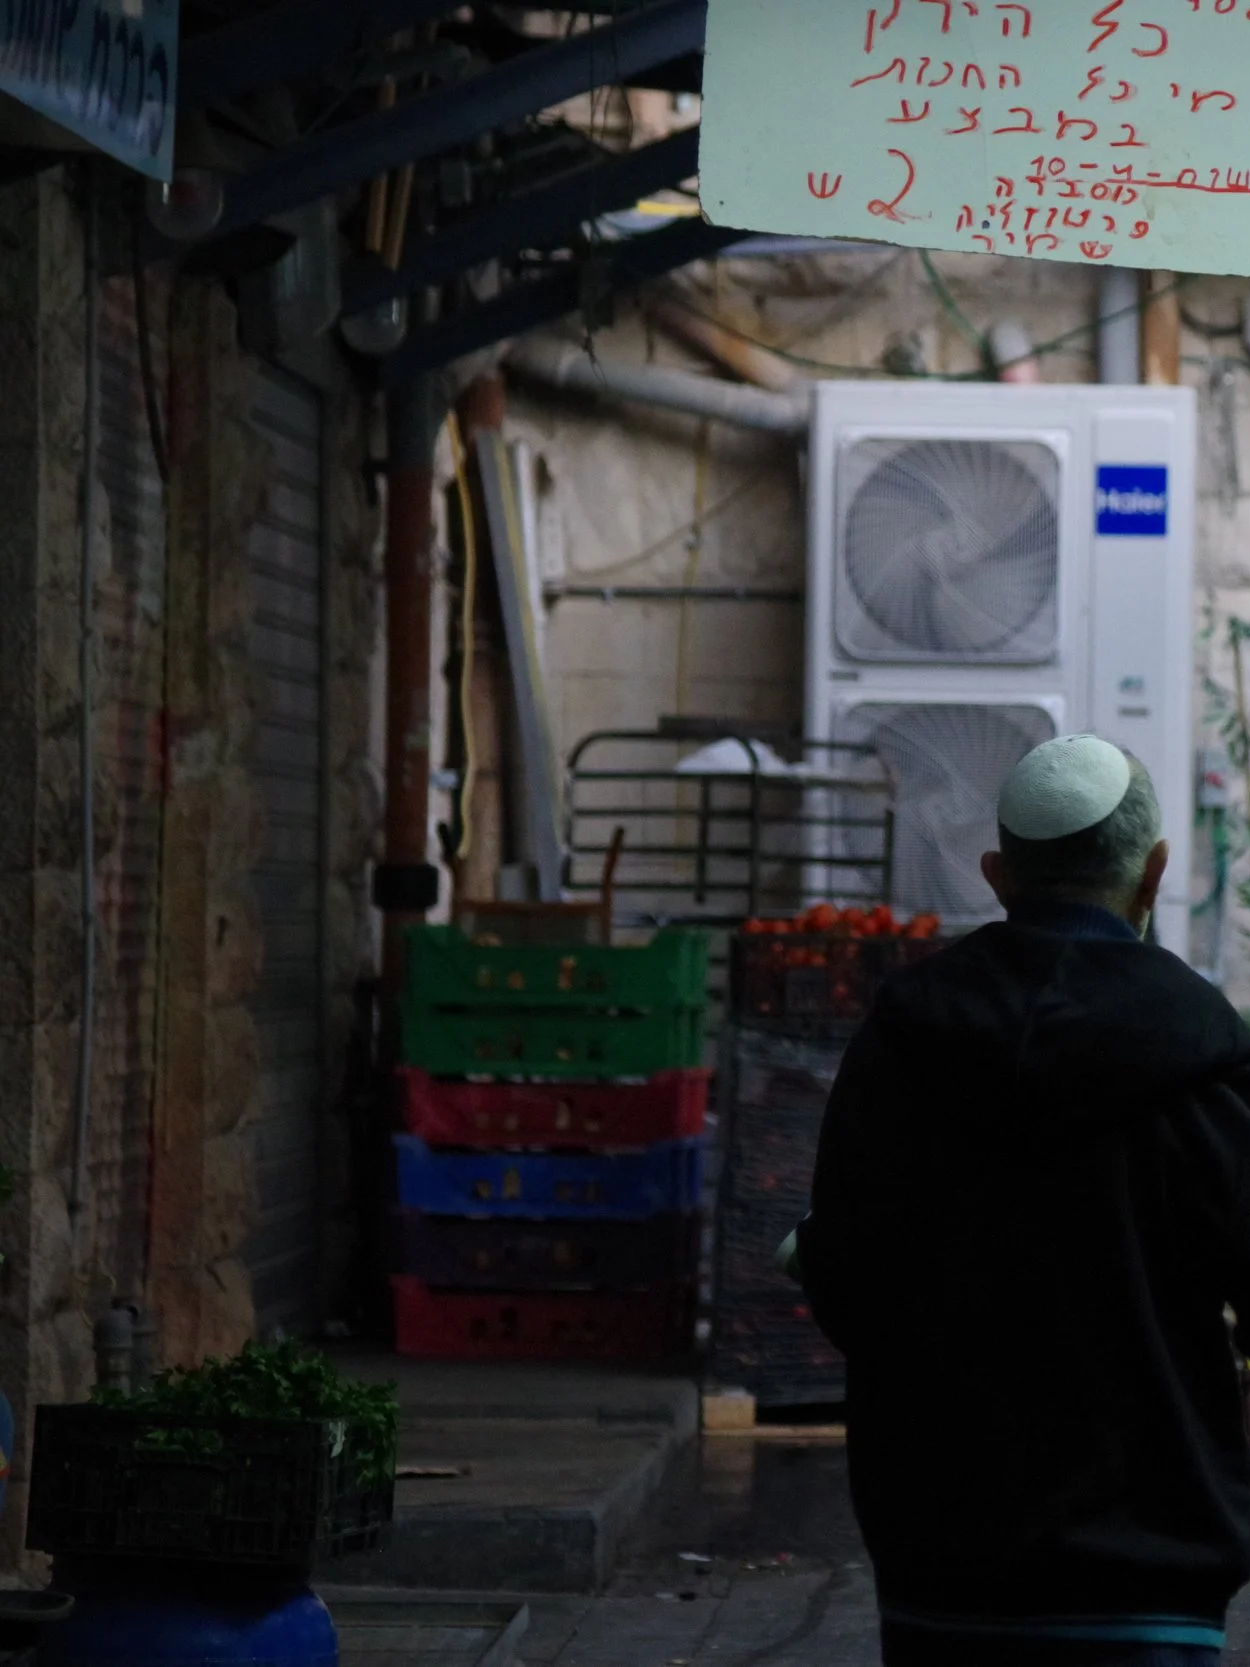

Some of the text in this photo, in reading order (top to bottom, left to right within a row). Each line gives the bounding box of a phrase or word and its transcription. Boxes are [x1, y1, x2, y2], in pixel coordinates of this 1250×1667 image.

[864, 0, 1169, 57] כל הירק
[1077, 64, 1136, 102] כל
[885, 98, 1147, 147] במבצע
